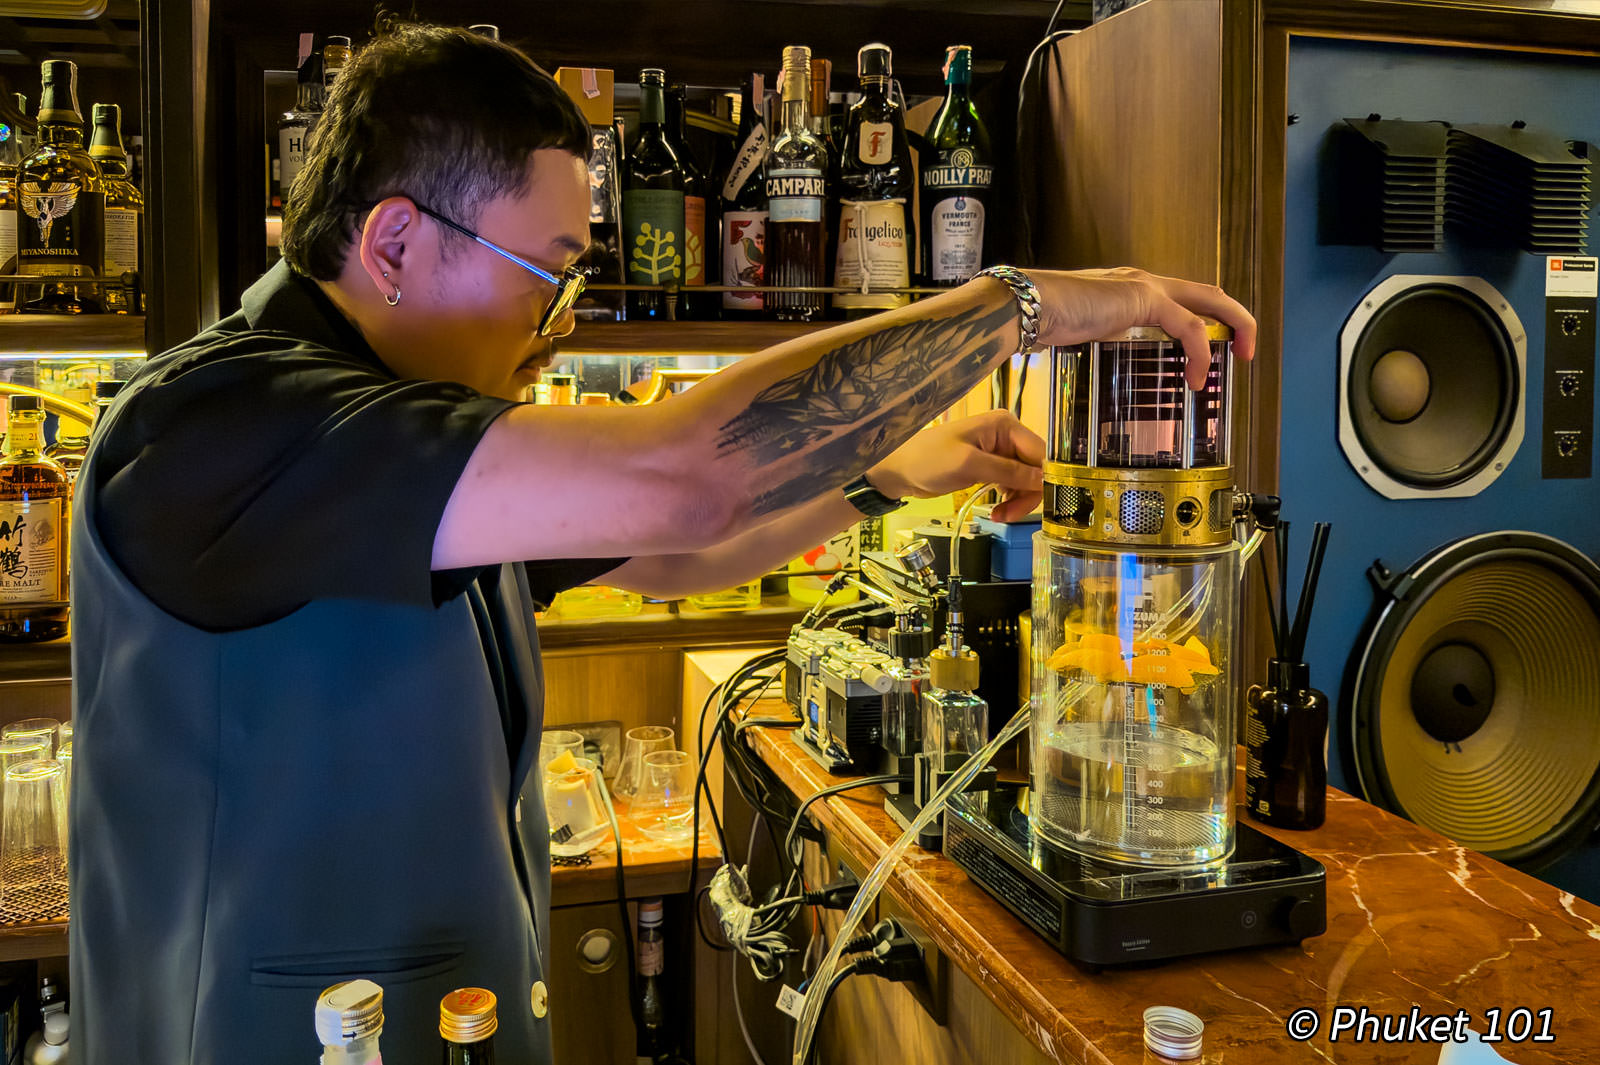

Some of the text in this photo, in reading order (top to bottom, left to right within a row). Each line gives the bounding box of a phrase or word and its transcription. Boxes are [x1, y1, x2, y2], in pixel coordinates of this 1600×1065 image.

[924, 168, 966, 186] NOILLY
[766, 178, 825, 197] CAMPARI
[13, 578, 42, 588] MALT
[1147, 780, 1164, 788] 400
[1147, 796, 1164, 805] 300
